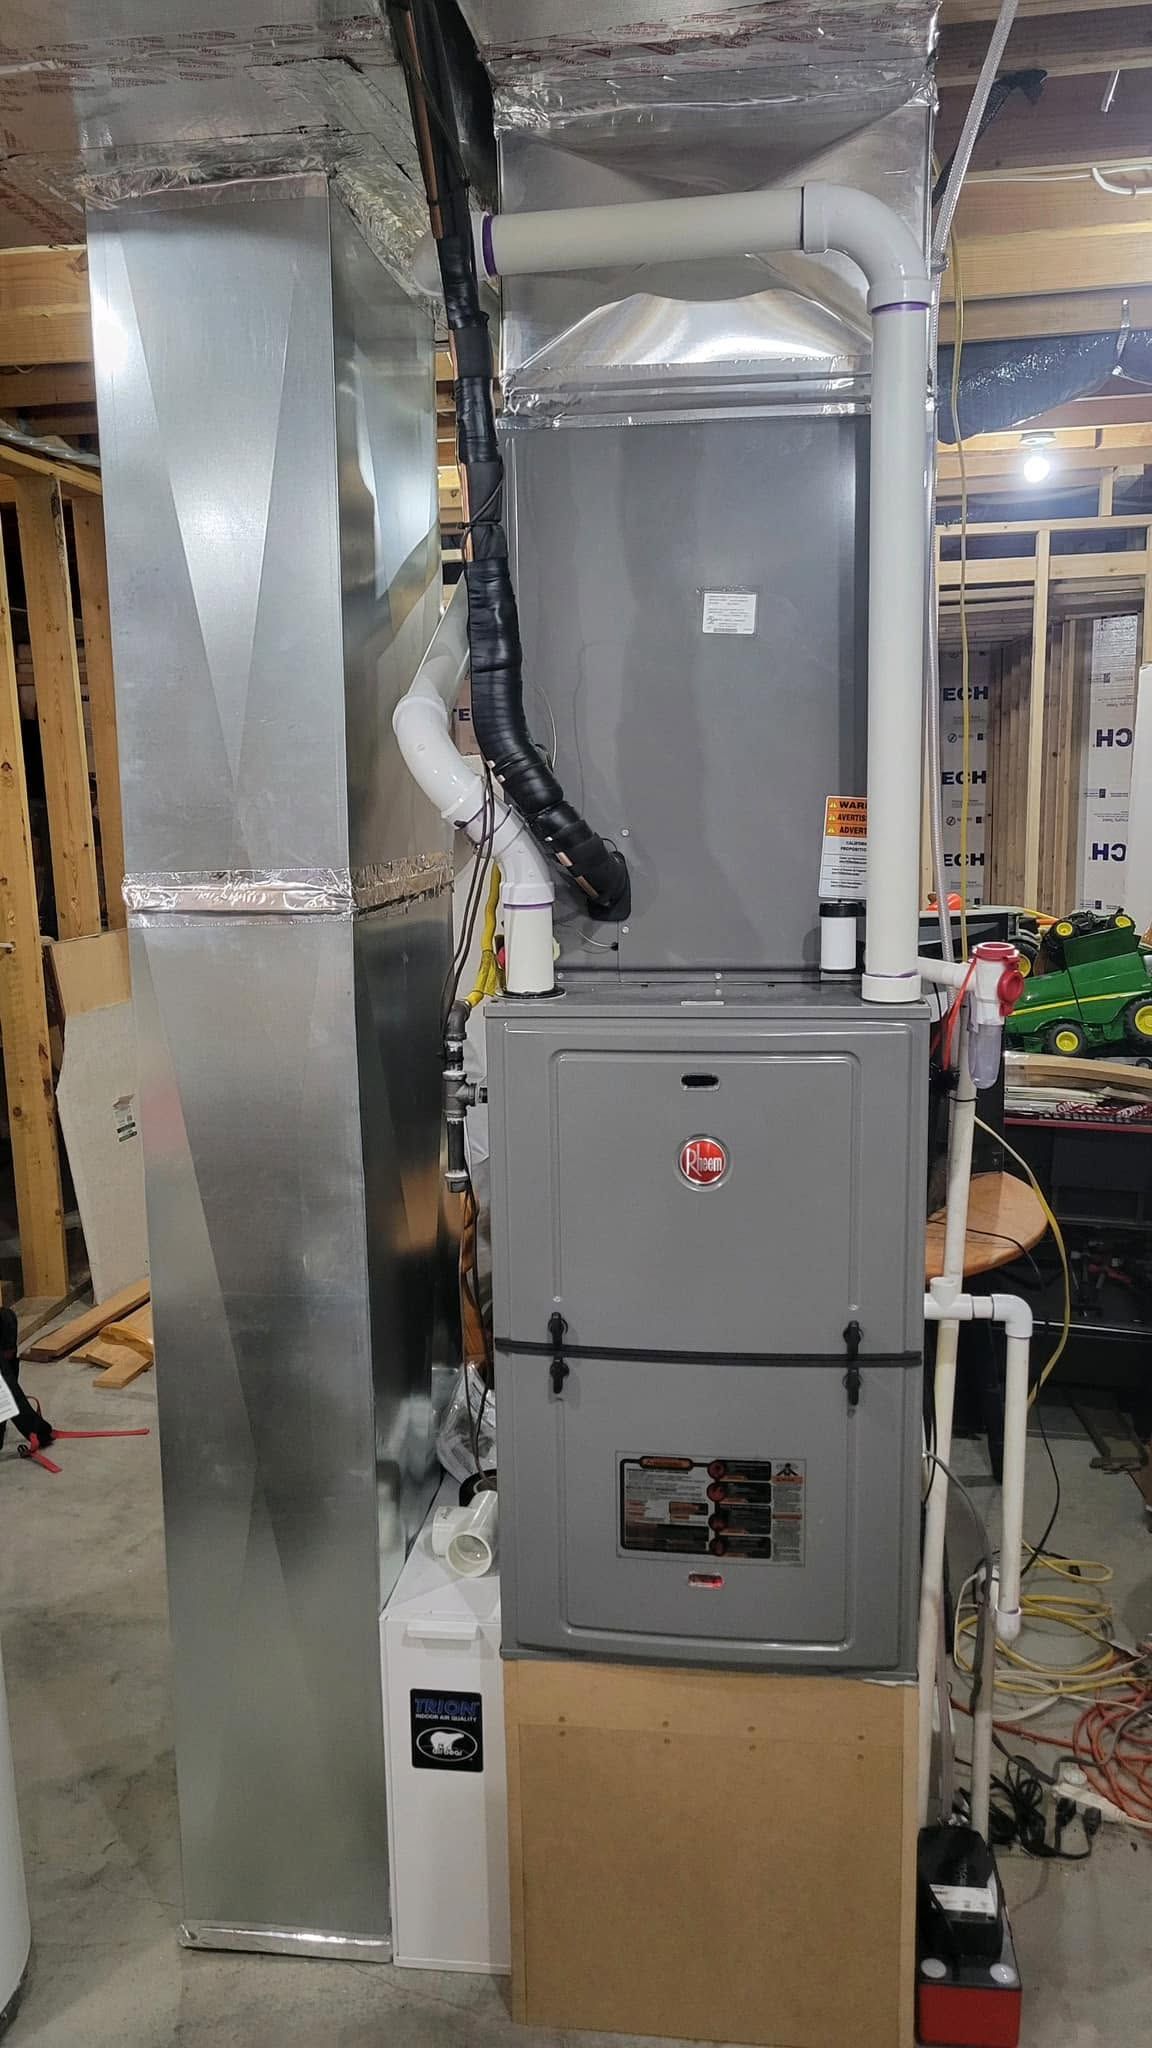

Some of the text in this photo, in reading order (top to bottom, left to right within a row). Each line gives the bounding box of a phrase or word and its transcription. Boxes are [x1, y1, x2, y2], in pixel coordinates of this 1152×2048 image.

[839, 801, 867, 809] WAR
[837, 814, 867, 822] AVERTIS
[686, 1143, 723, 1177] Rheem
[415, 1698, 477, 1716] TRION
[451, 1715, 477, 1723] QUALITY
